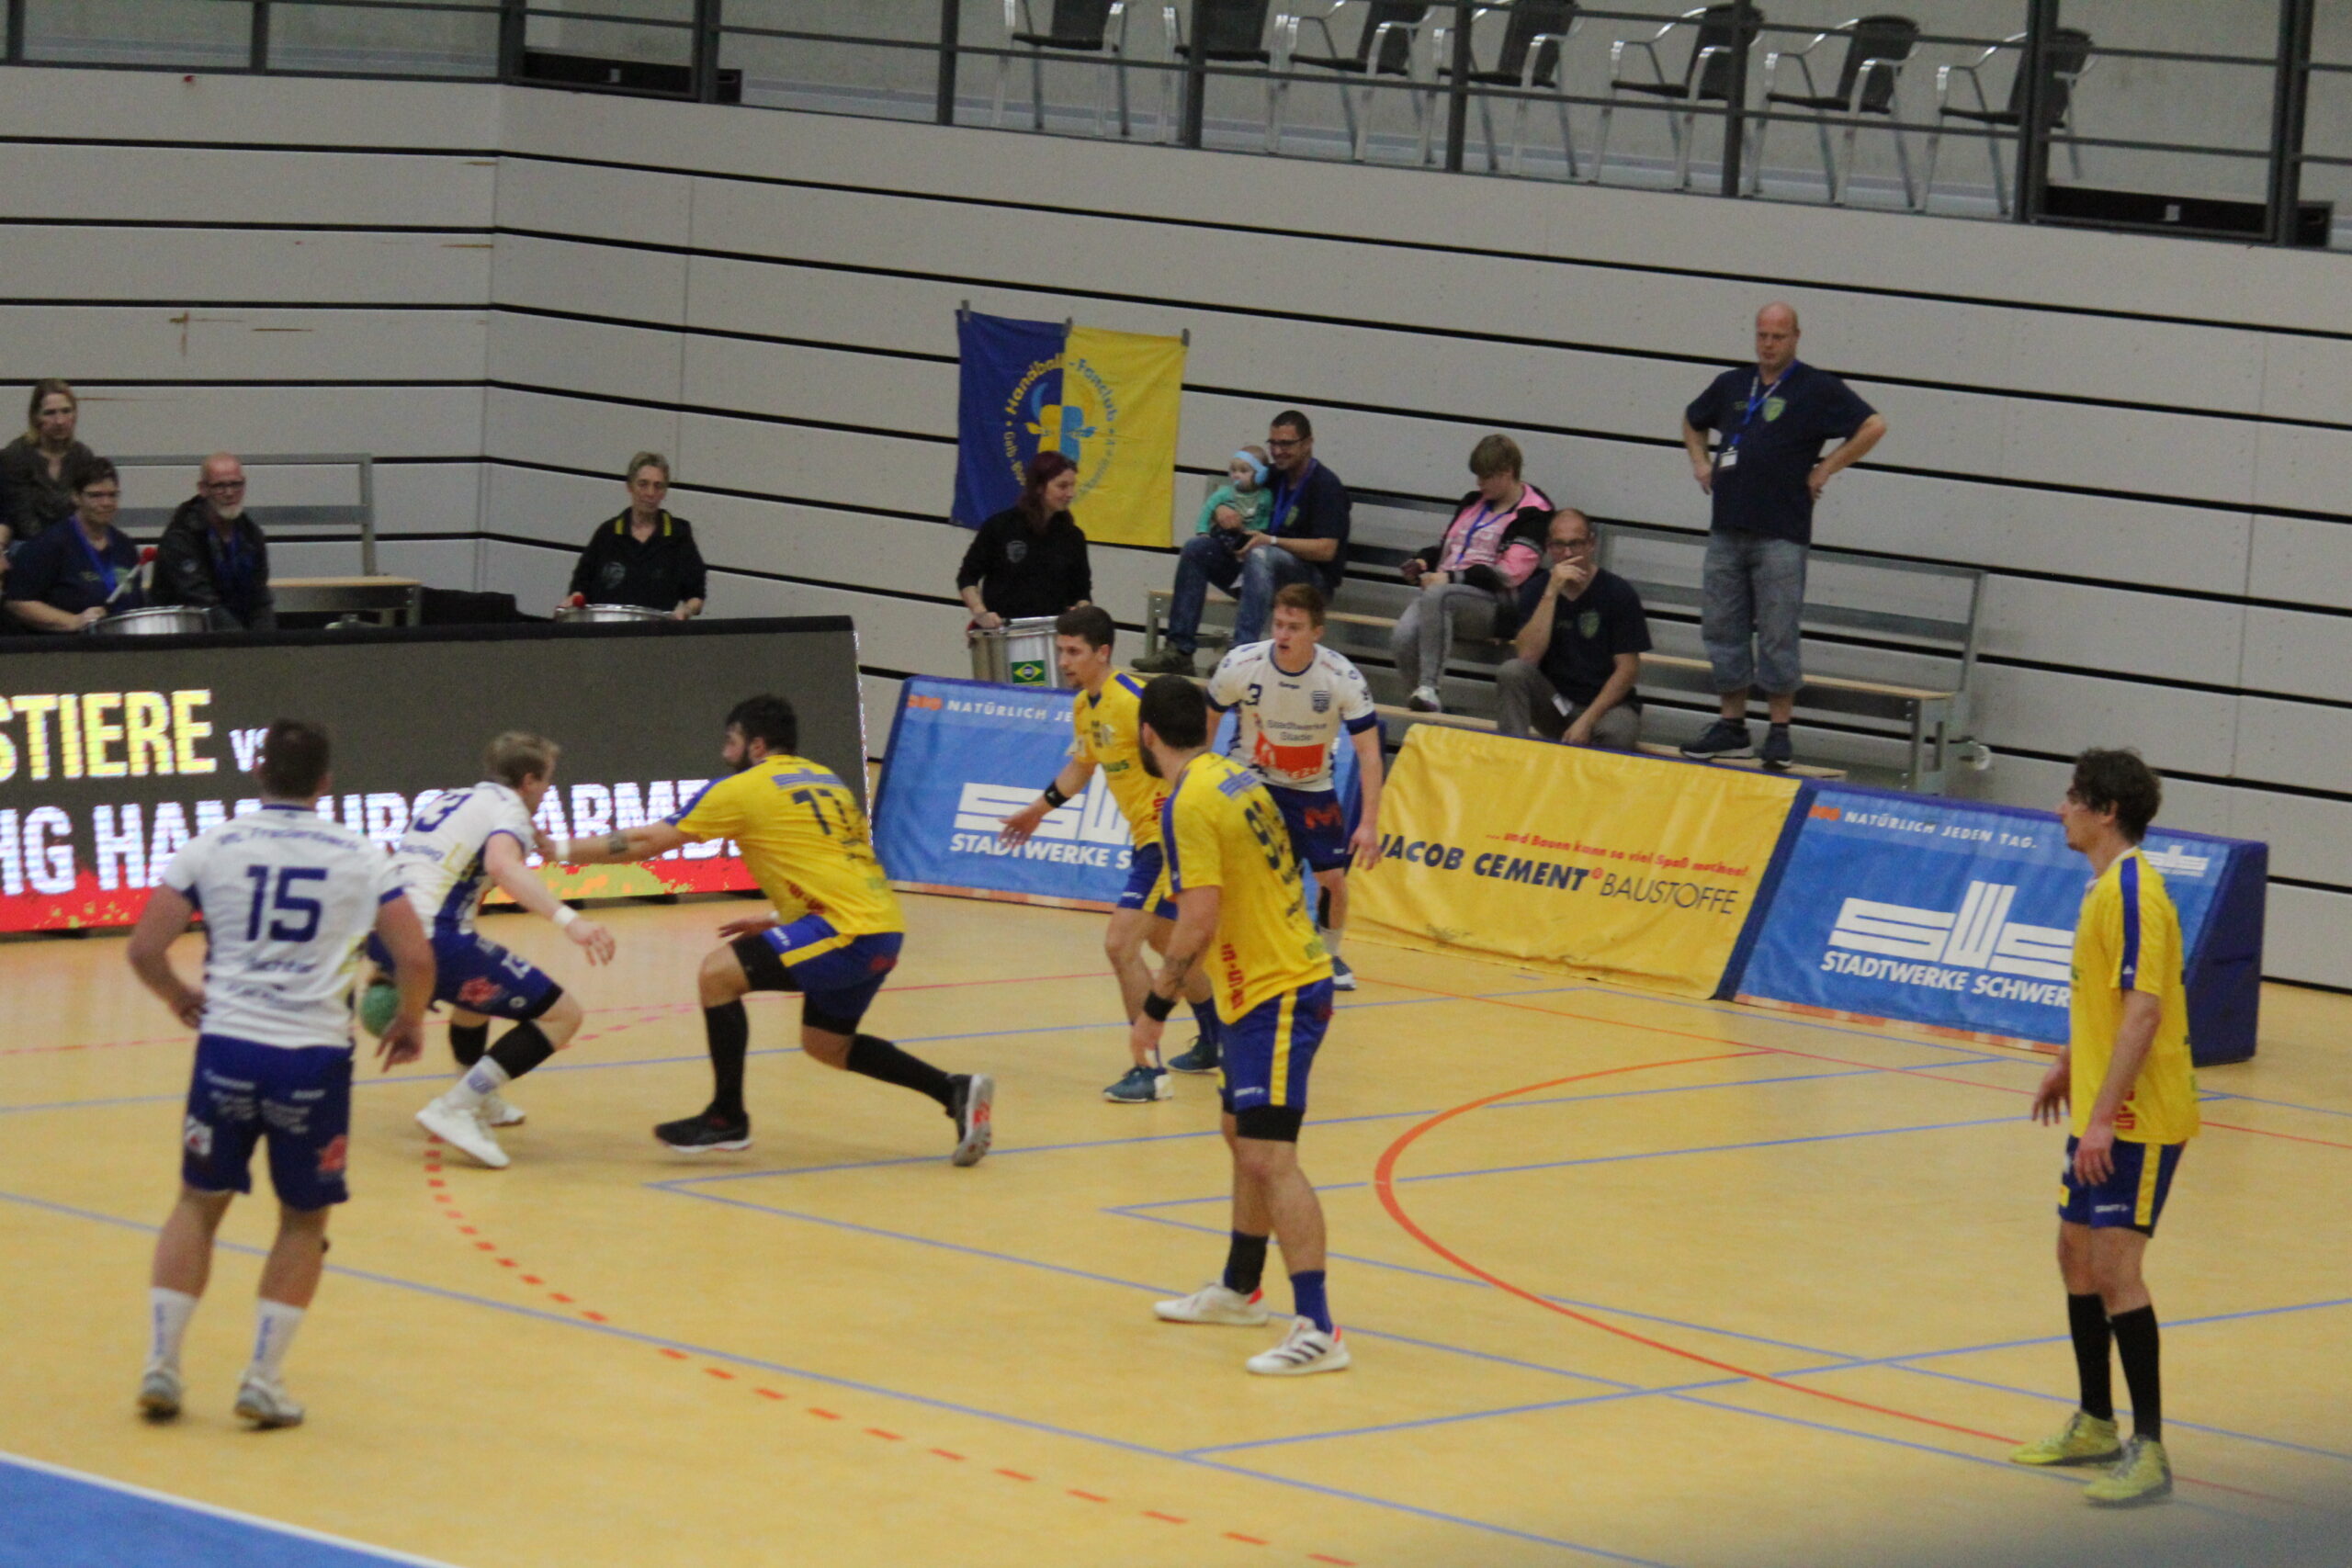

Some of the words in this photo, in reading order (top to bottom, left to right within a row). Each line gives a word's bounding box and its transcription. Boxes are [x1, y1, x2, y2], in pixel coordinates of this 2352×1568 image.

[947, 700, 1047, 720] NATÜRLICH
[1245, 682, 1263, 706] 3
[1845, 811, 1937, 834] NATÜRLICH
[1940, 826, 1993, 842] JEDEN
[1998, 833, 2037, 848] TAG.
[950, 833, 1110, 867] STADTWERKE
[1573, 840, 1607, 856] kann
[1610, 850, 1624, 860] so
[1629, 851, 1654, 863] viel
[1655, 854, 1689, 869] Spaß
[1380, 833, 1464, 870] JACOB
[1600, 873, 1738, 914] BAUSTOFFE
[246, 865, 328, 942] 15
[1821, 950, 1970, 991] STADTWERKE
[1972, 975, 2071, 1008] SCHWER
